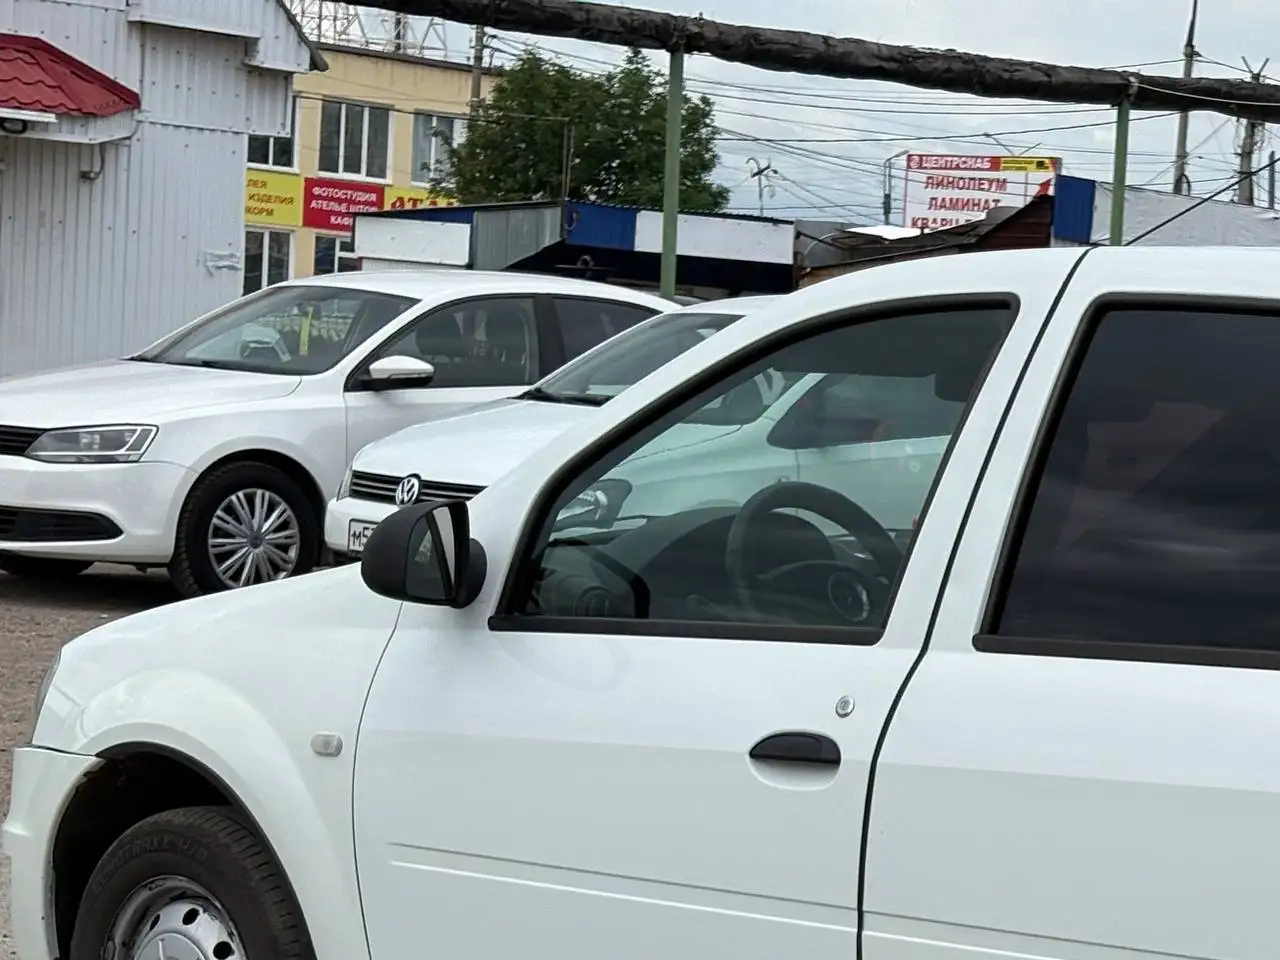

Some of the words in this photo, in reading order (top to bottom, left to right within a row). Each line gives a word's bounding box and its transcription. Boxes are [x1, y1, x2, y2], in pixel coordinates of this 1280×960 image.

[921, 156, 991, 169] ЦЕНТРСНАБ
[924, 176, 1007, 191] ЛИНОЛЕУМ
[248, 193, 294, 206] ИЗДЕЛИЯ
[312, 186, 377, 202] ФОТОСТУДИЯ
[928, 197, 1002, 212] ЛАМИНАТ
